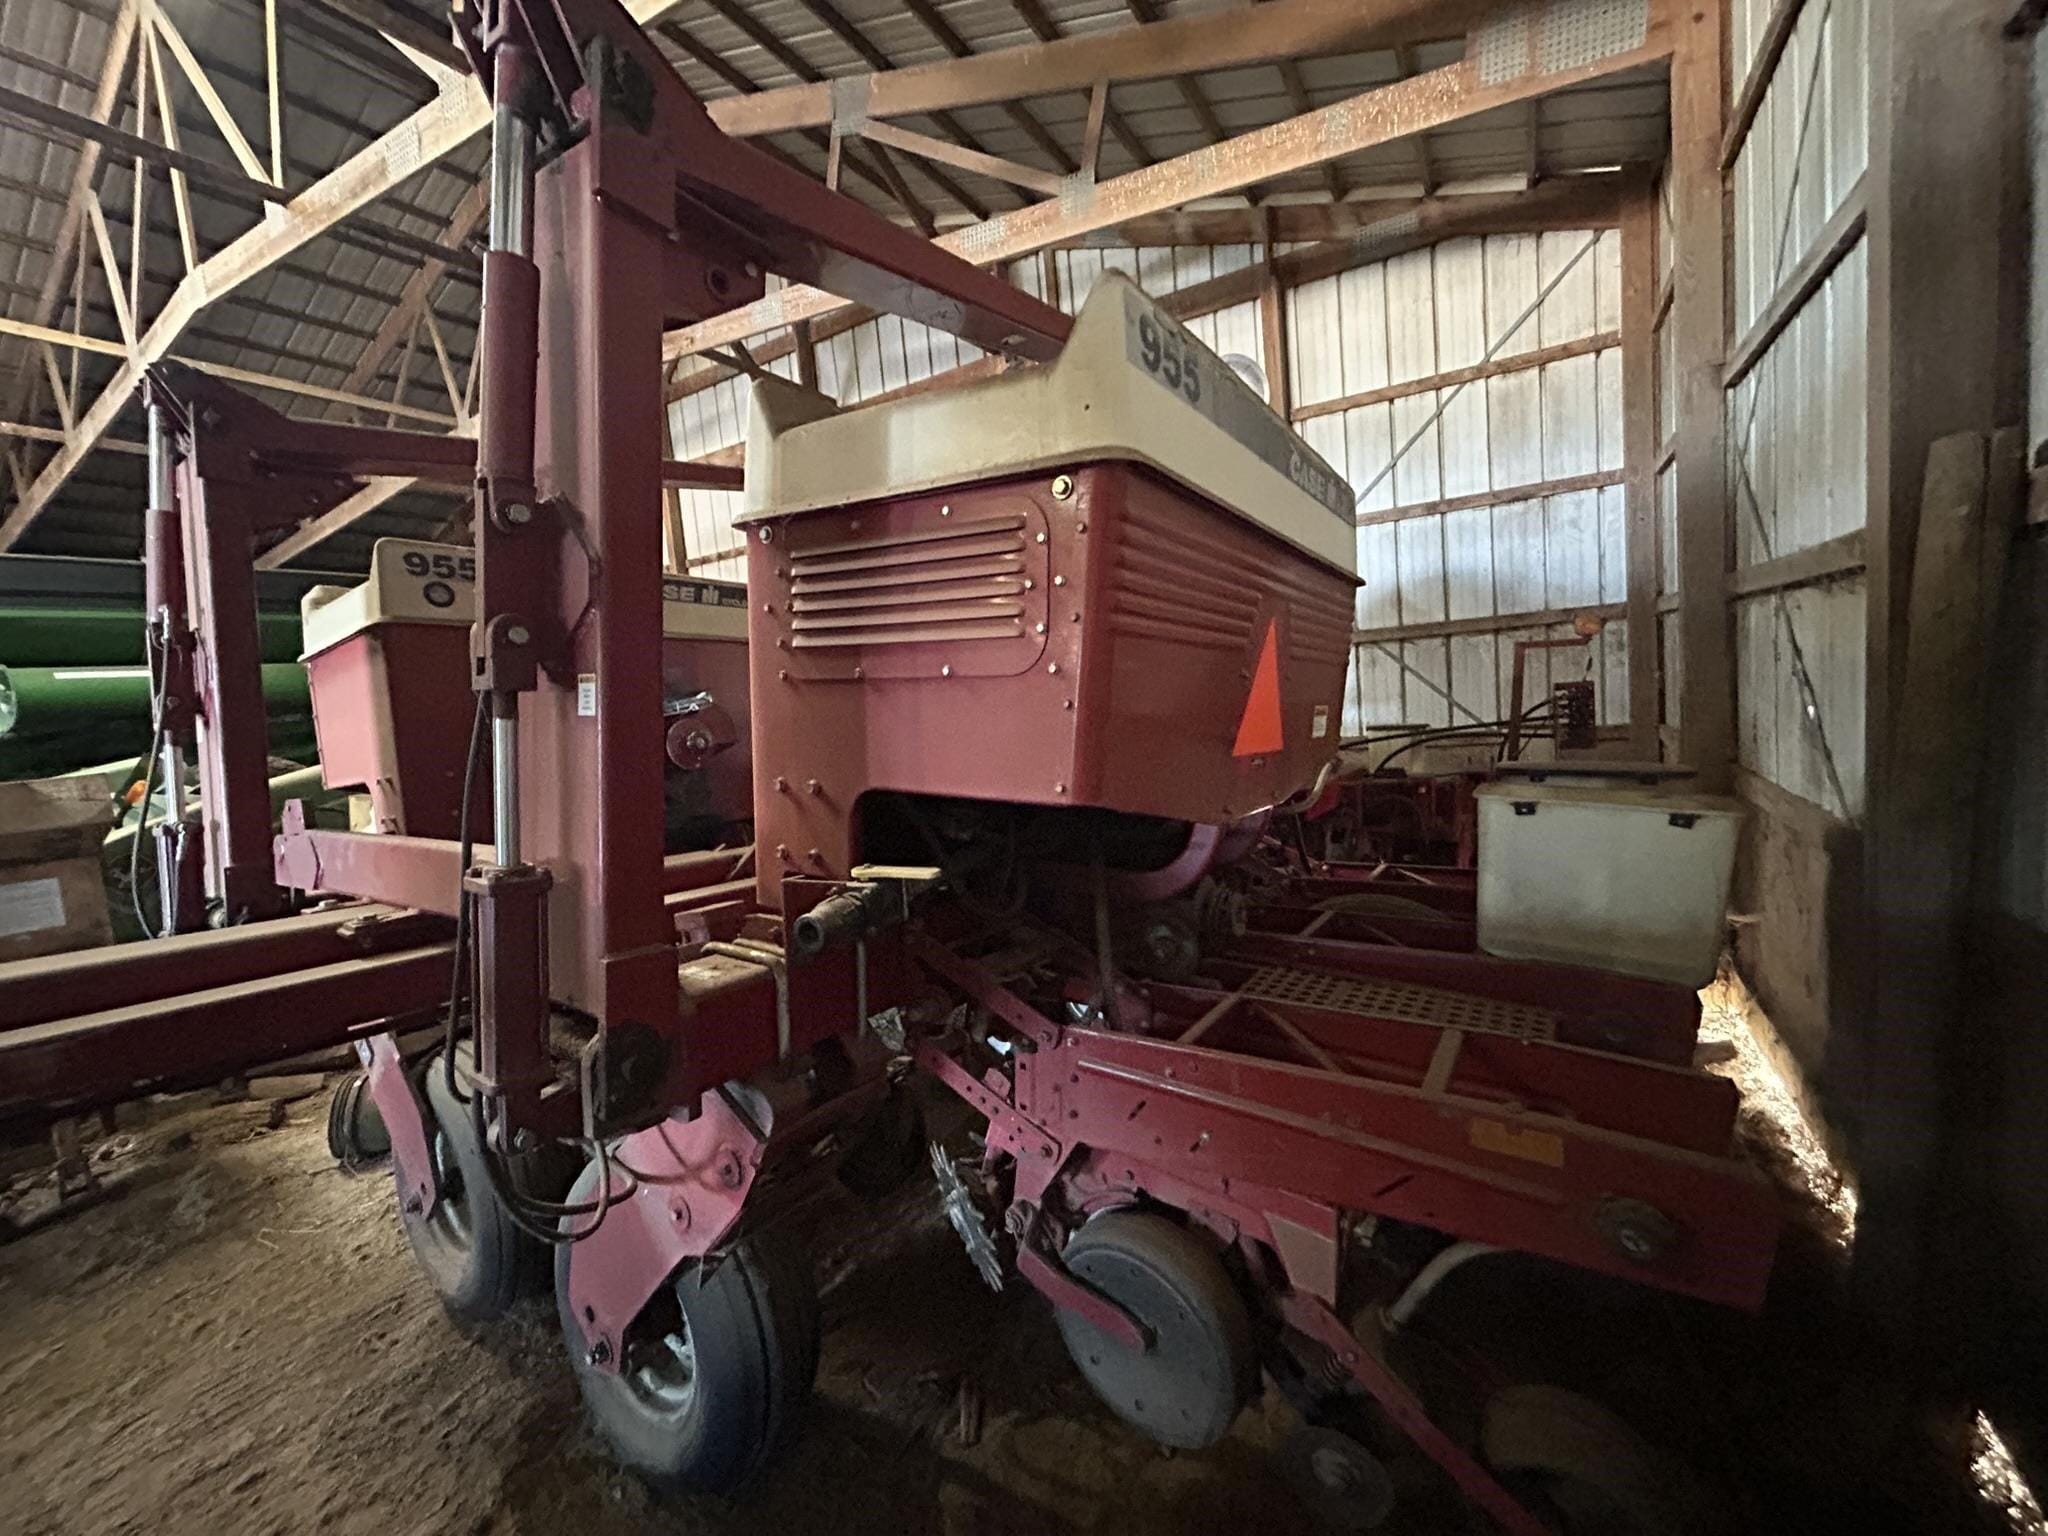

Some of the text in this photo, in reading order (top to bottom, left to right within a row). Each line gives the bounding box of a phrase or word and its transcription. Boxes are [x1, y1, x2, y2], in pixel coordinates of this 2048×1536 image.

[1139, 313, 1200, 402] 955
[403, 552, 476, 582] 955
[663, 584, 696, 602] SE
